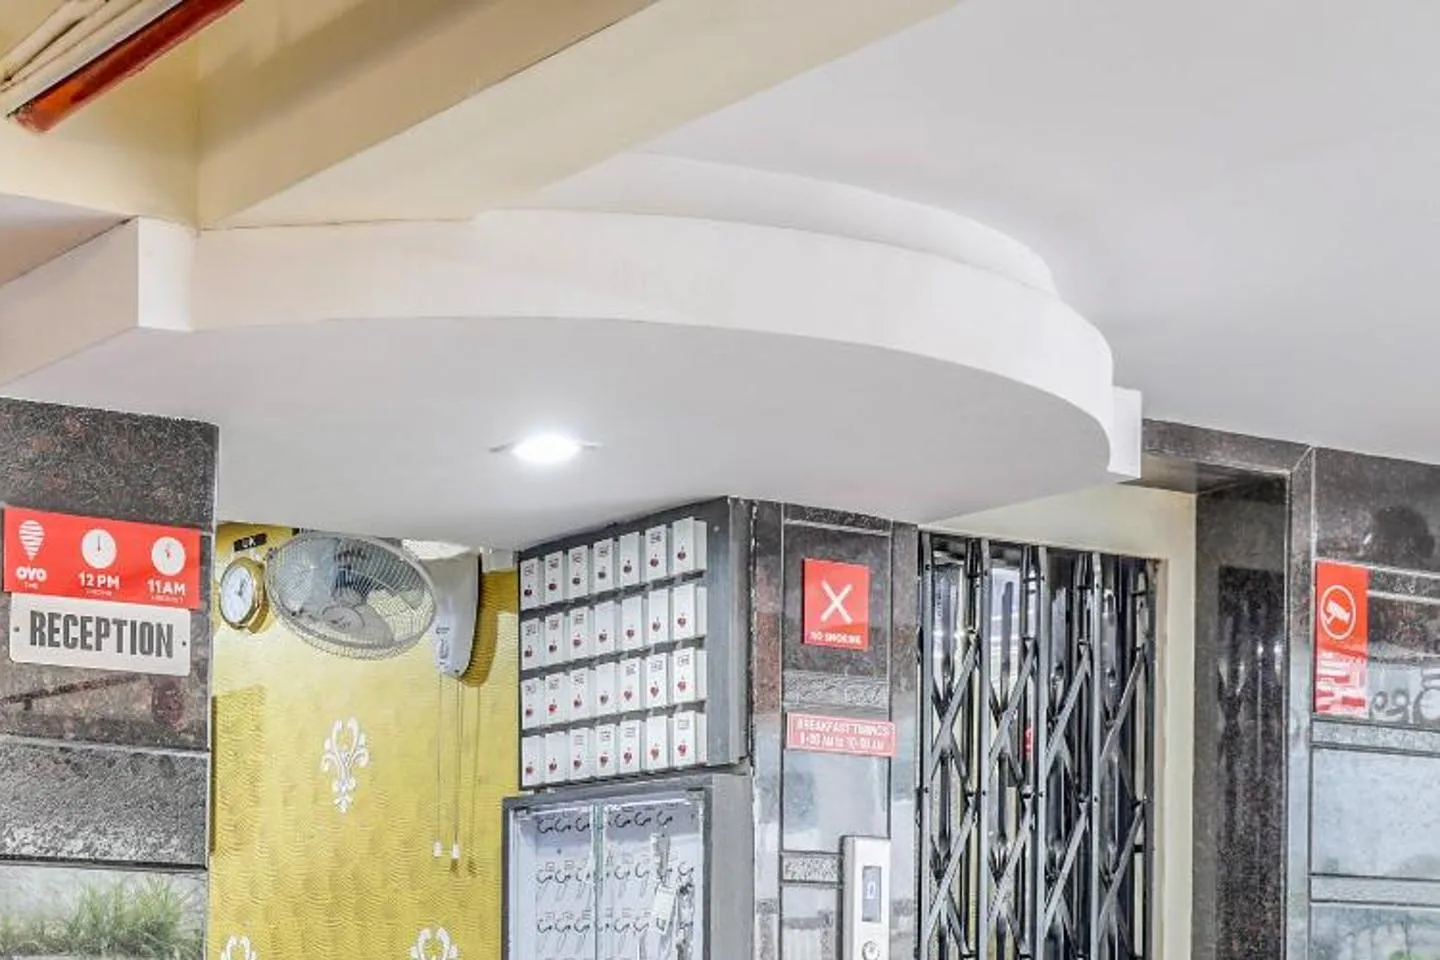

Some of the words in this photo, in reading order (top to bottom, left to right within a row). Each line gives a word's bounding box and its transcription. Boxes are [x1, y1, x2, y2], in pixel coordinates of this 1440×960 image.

[15, 566, 48, 582] OYO
[77, 572, 94, 587] 12
[97, 574, 120, 590] PM
[30, 610, 174, 658] RECEPTION
